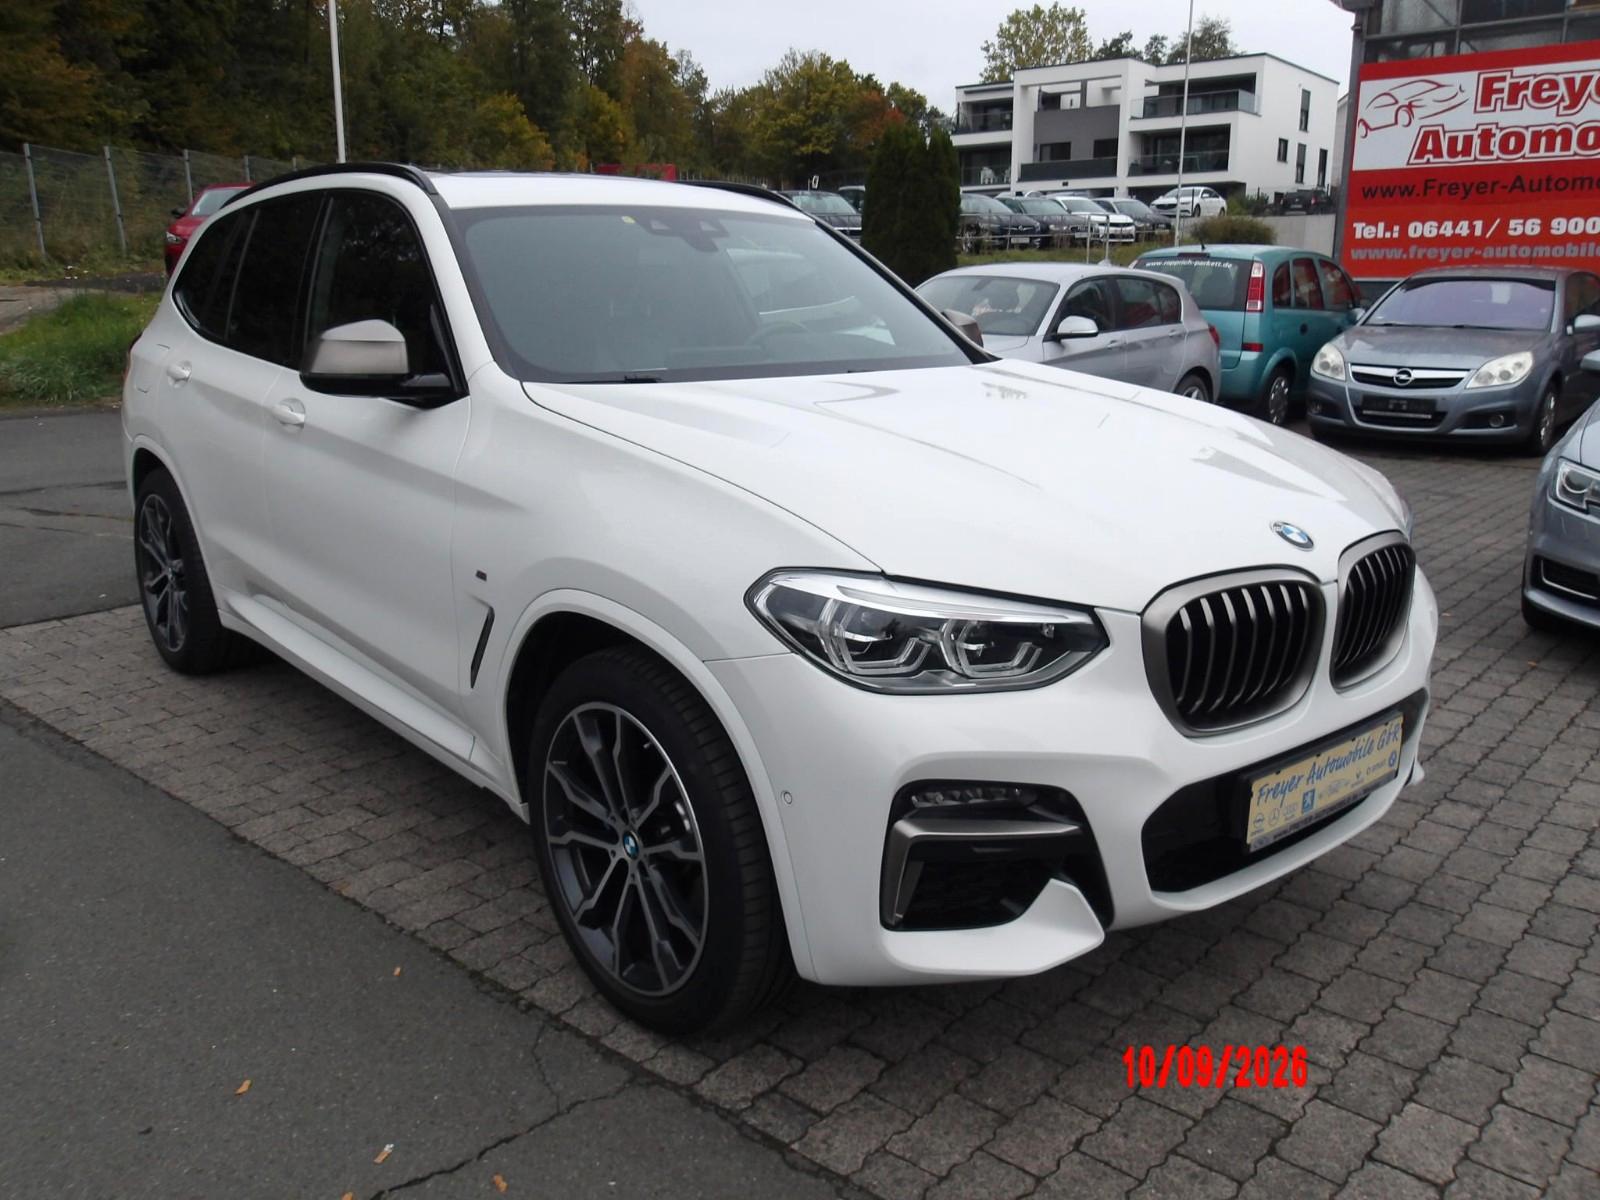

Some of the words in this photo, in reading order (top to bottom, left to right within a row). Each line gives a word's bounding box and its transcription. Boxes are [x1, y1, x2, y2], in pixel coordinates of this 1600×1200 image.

[1474, 69, 1600, 117] Frey
[1353, 221, 1400, 239] Tel.:
[1507, 218, 1542, 236] 56
[1257, 774, 1304, 808] Freyer
